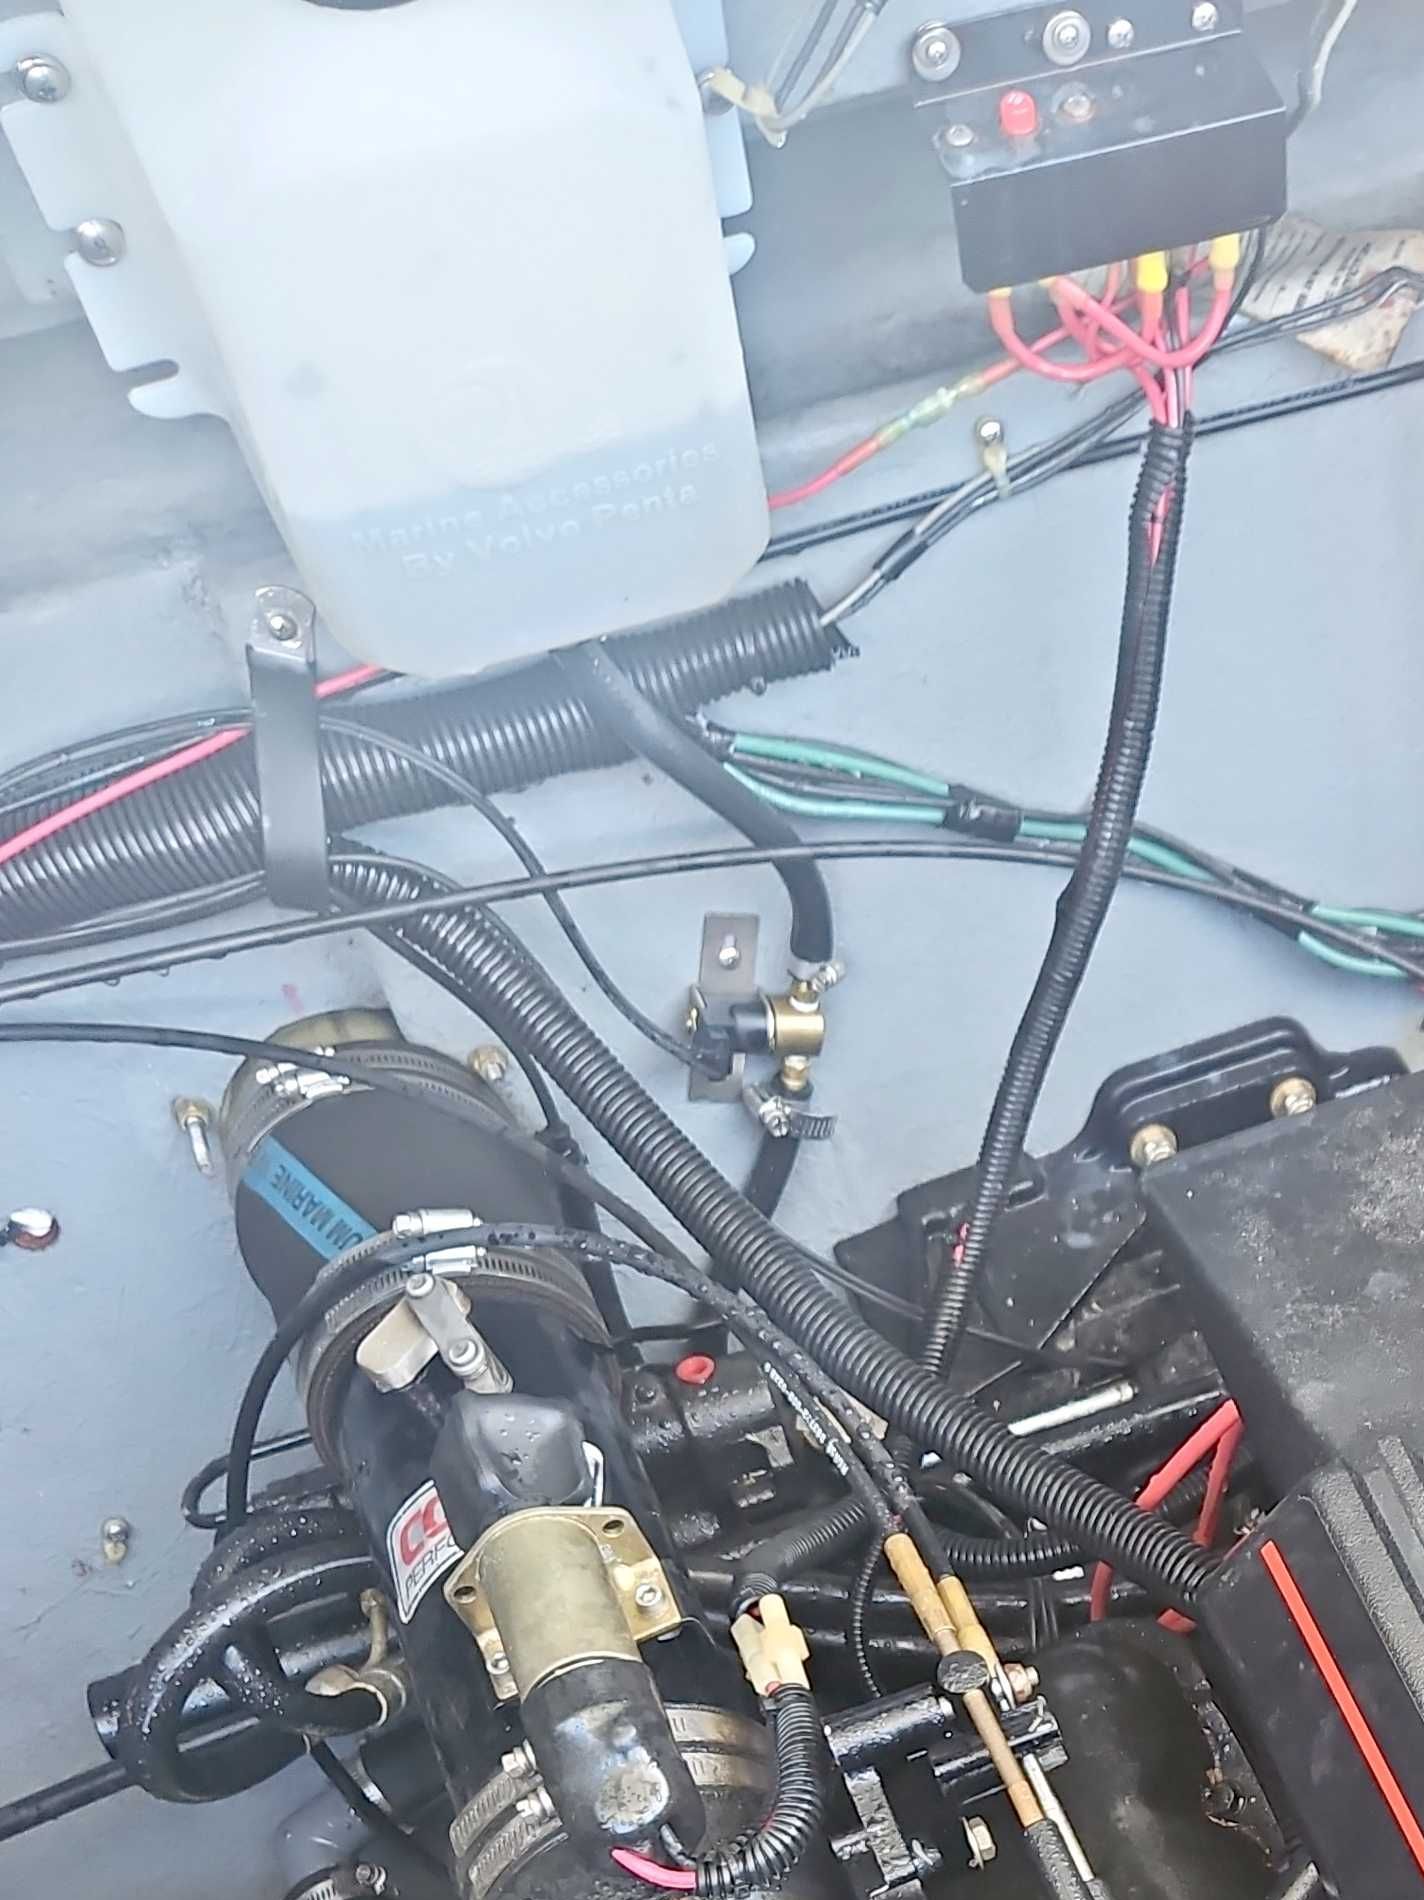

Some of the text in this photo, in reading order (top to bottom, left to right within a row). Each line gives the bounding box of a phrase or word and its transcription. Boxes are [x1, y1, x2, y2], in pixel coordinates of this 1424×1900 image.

[351, 441, 721, 552] Marine Accessories
[402, 484, 698, 578] By Volvo Penta
[263, 1163, 338, 1232] MARINE
